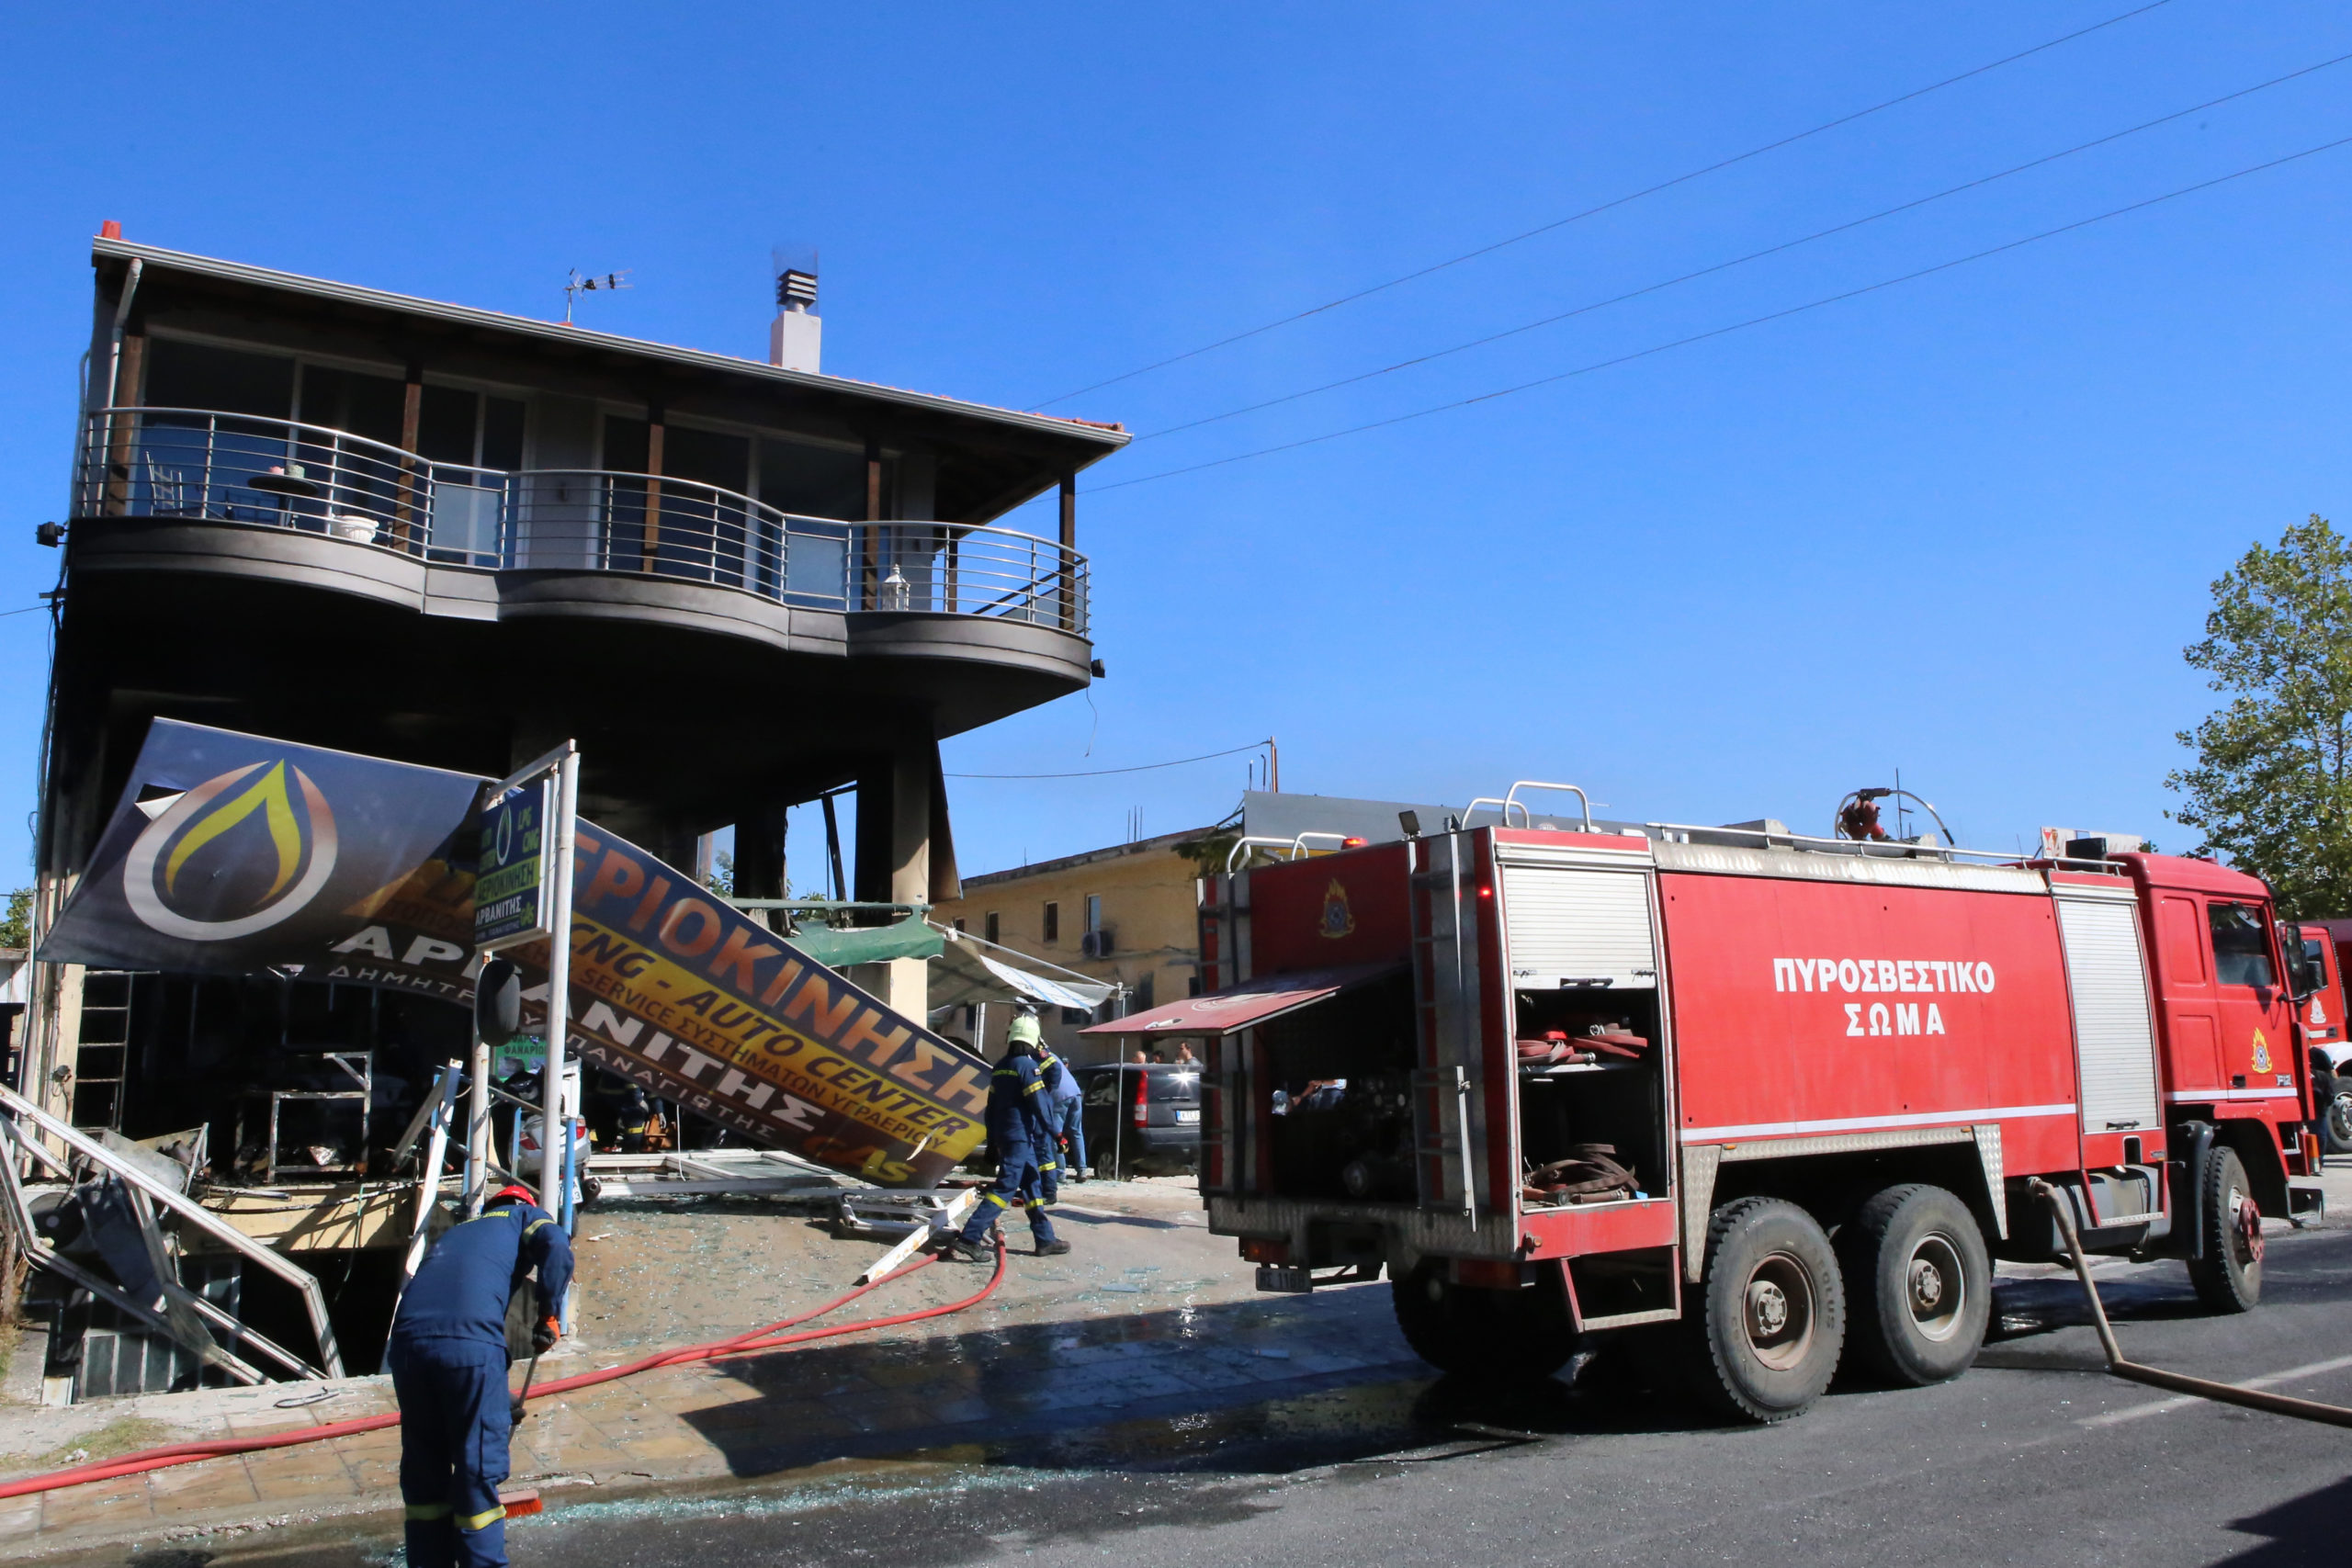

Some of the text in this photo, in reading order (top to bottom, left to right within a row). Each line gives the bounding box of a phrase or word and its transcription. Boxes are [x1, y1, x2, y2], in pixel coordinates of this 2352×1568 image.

[475, 896, 522, 927] ΑΡΒΑΝΙΤΗΣ
[1773, 957, 1996, 994] ΠΥΡΟΣΒΕΣΤΙΚΟ
[1845, 1001, 1946, 1038] ΣΩΜΑ
[566, 1033, 775, 1139] ΠΑΝΑΓΙΩΤΗΣ
[580, 966, 676, 1026] SERVICE
[676, 1015, 827, 1099] ΣΥΣΤΗΜΑΤΩΝ
[832, 1091, 948, 1151] ΥΓΡΑΕΡΙΟΥ
[675, 989, 804, 1057] AUTO
[805, 1055, 970, 1137] CENTER
